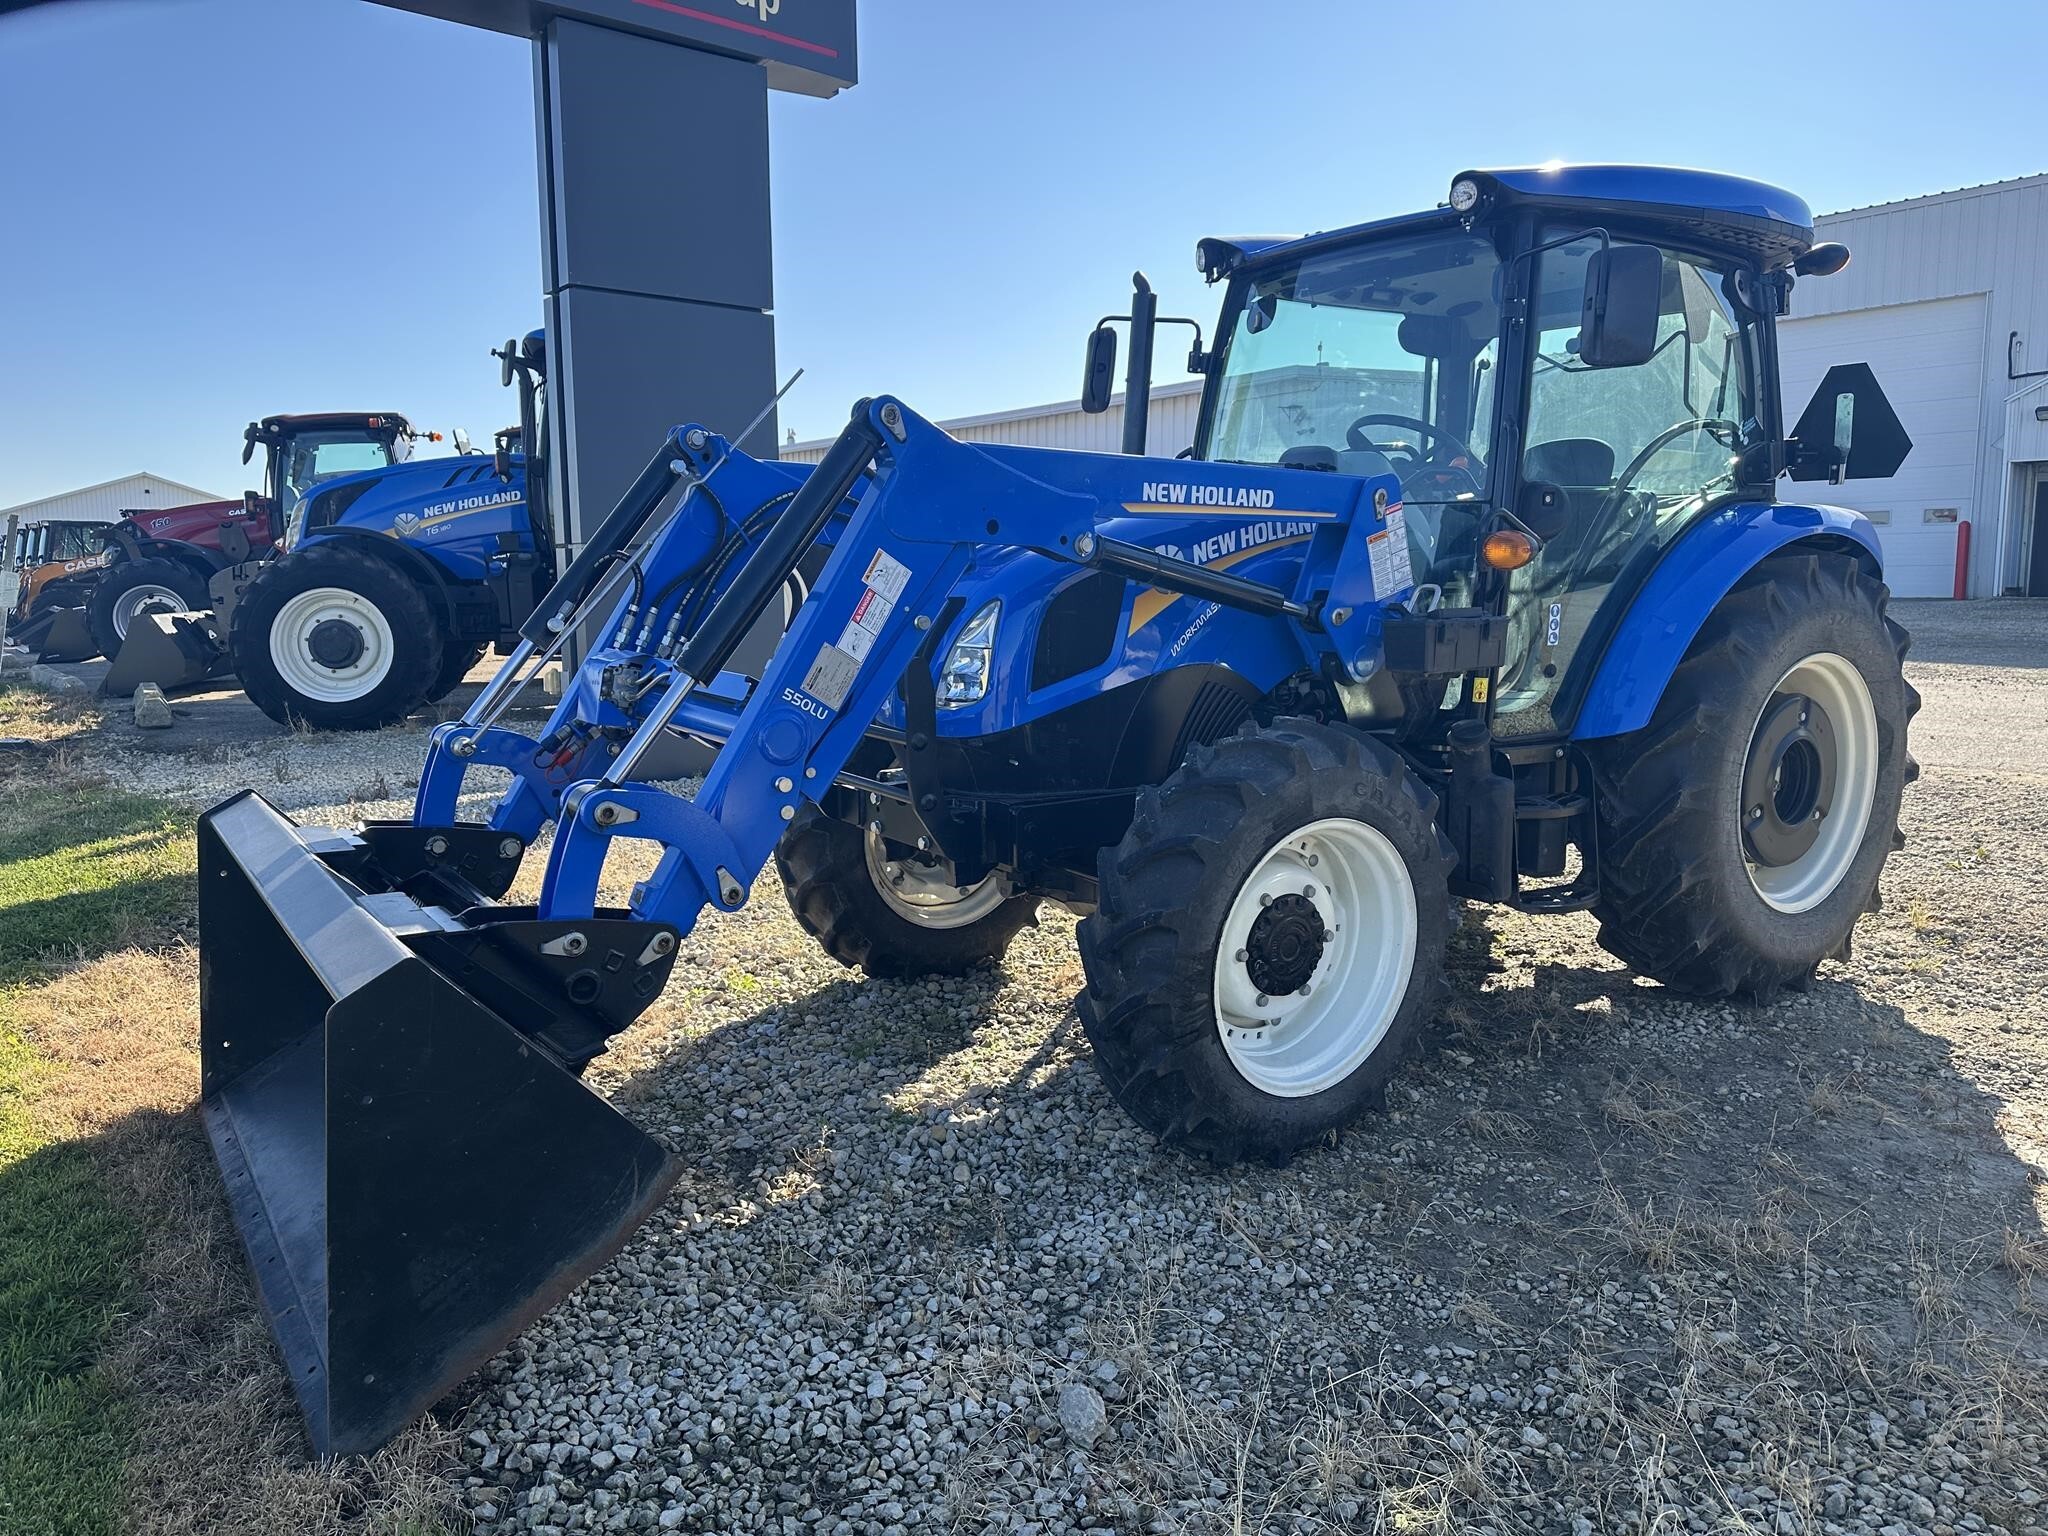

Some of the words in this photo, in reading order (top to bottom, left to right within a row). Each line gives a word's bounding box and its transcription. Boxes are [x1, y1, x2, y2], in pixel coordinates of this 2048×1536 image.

[423, 500, 456, 518] NEW
[458, 490, 522, 511] HOLLAND
[1142, 482, 1187, 503] NEW
[1191, 485, 1275, 508] HOLLAND
[1192, 530, 1236, 566] NEW
[1170, 602, 1222, 657] WORKMAS
[782, 687, 829, 720] 550LU
